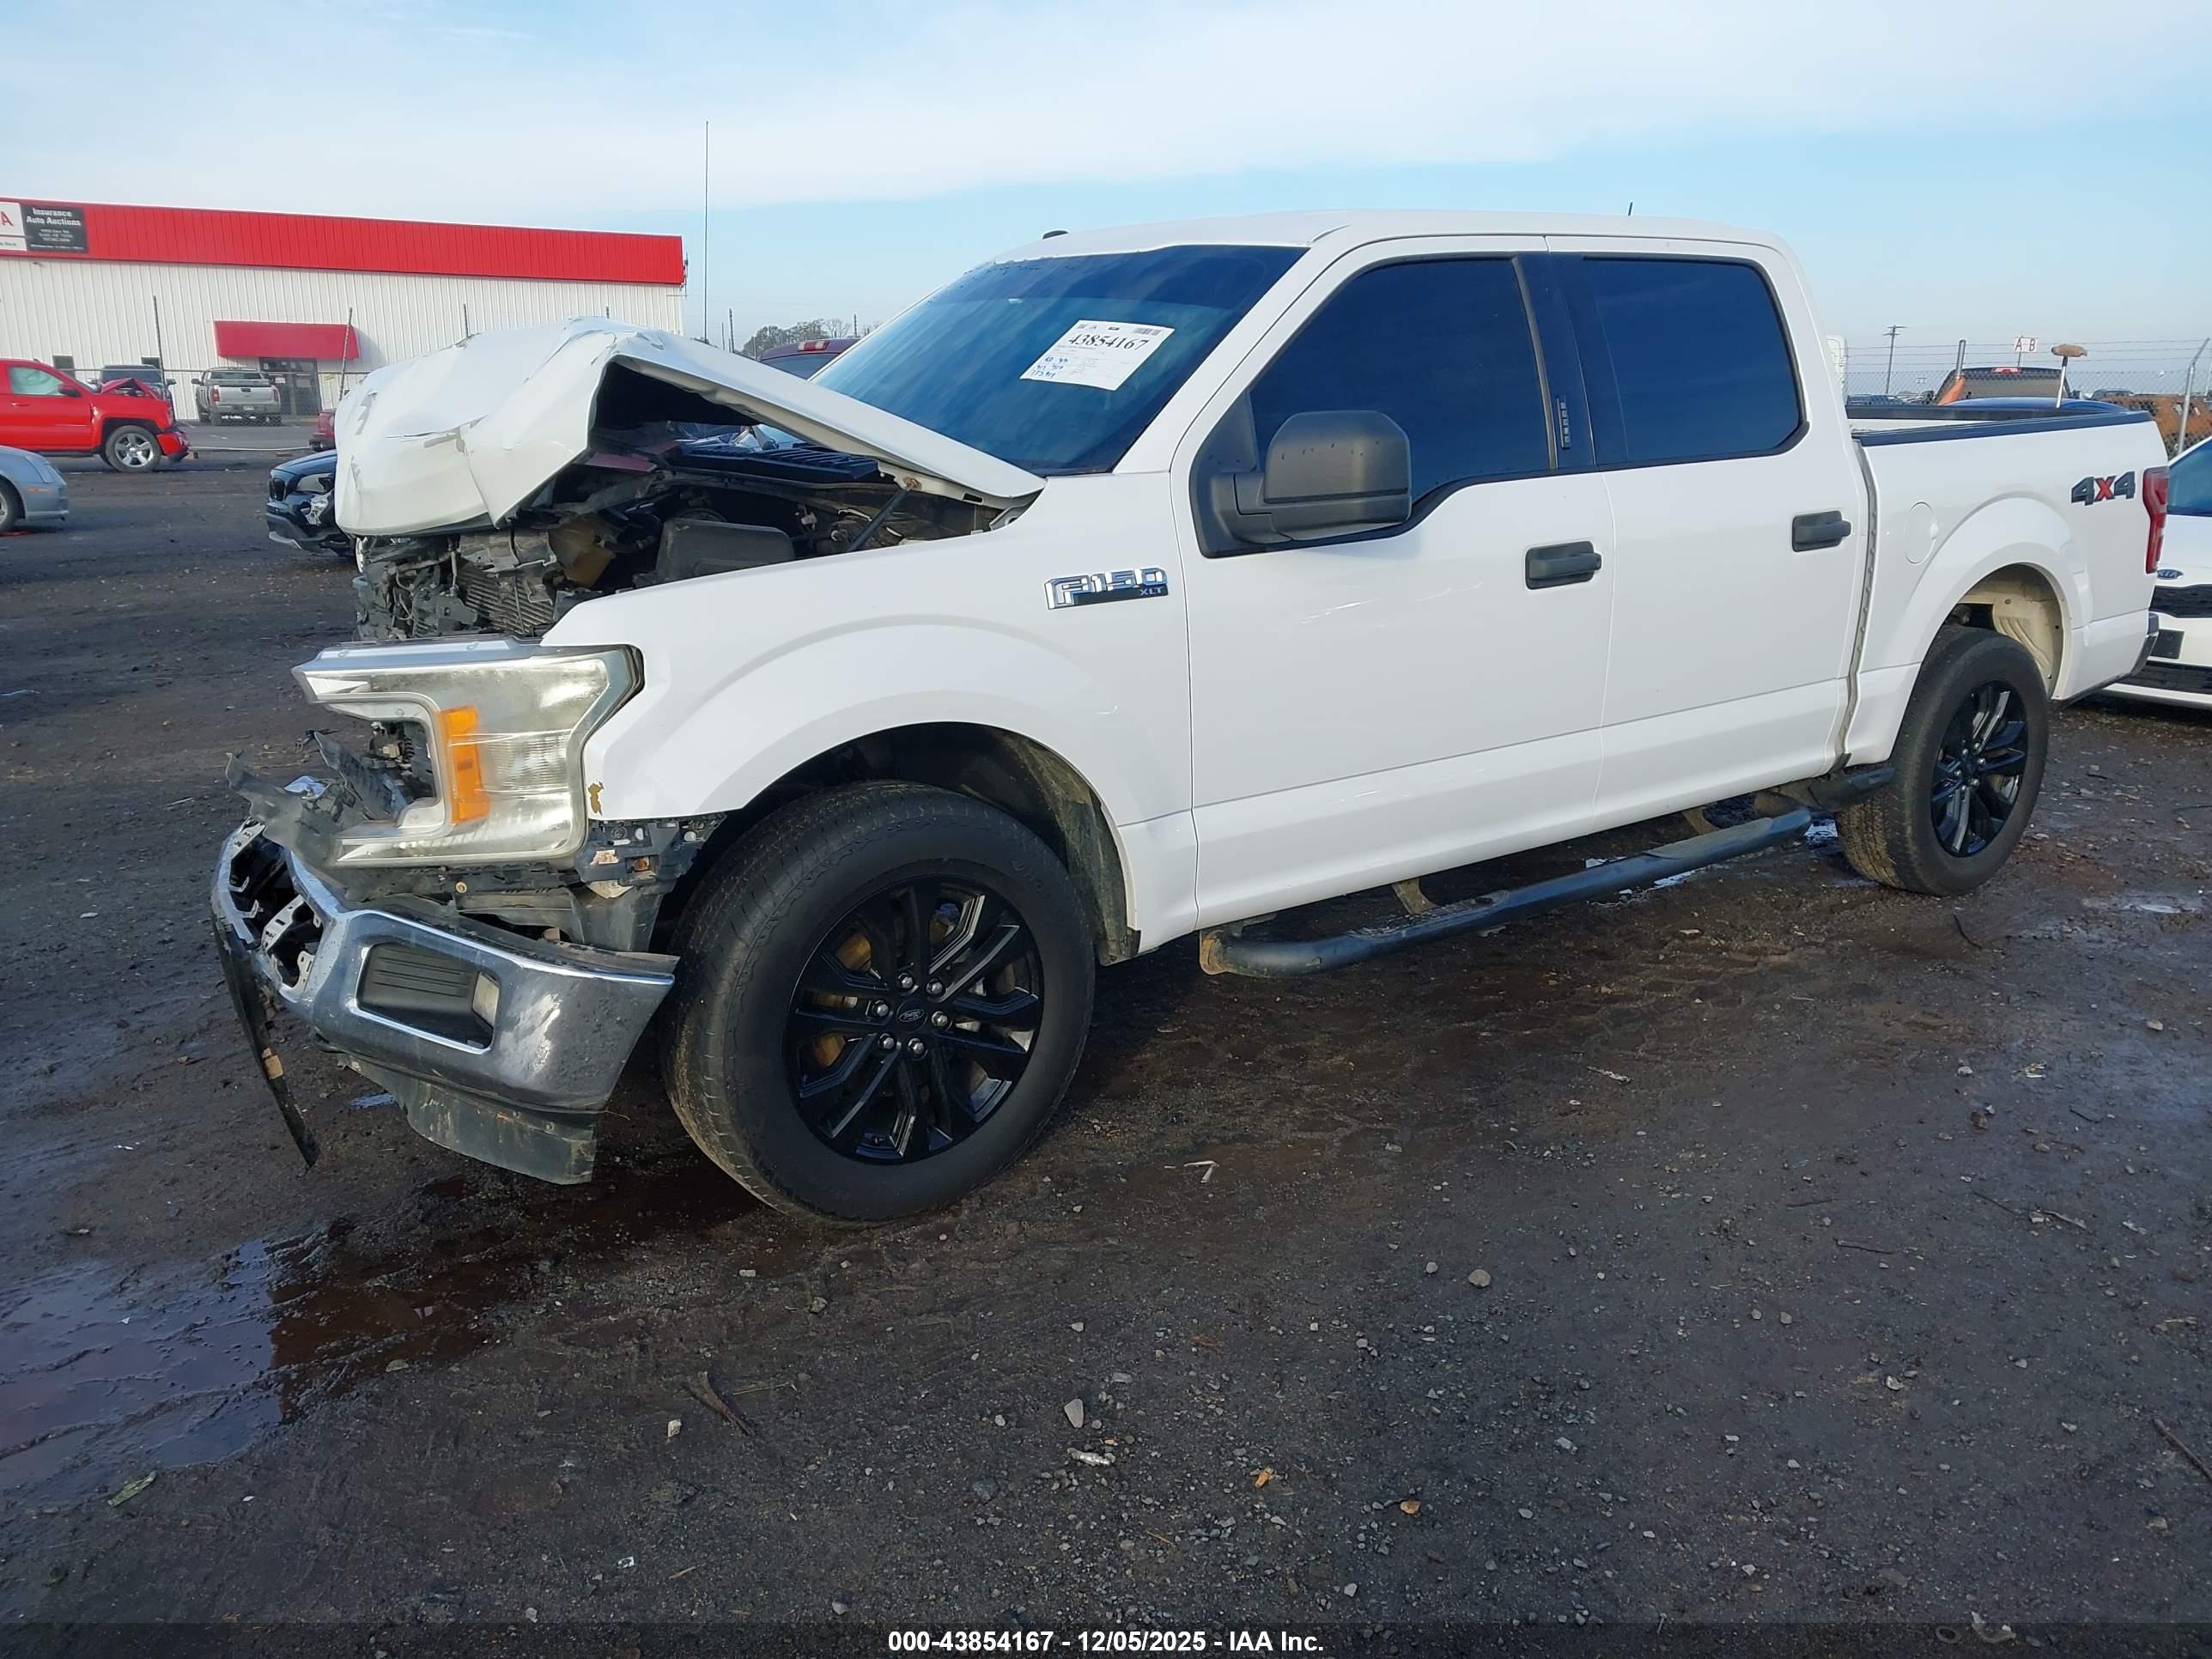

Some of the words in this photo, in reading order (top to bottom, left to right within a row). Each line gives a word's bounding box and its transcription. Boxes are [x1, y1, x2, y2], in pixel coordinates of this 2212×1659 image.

[33, 208, 72, 217] Insurance
[27, 216, 45, 224] Auto
[47, 216, 82, 226] Auctions
[1068, 333, 1150, 350] 43854167
[2014, 337, 2022, 351] A
[2029, 338, 2036, 351] B
[1139, 587, 1163, 596] XLT
